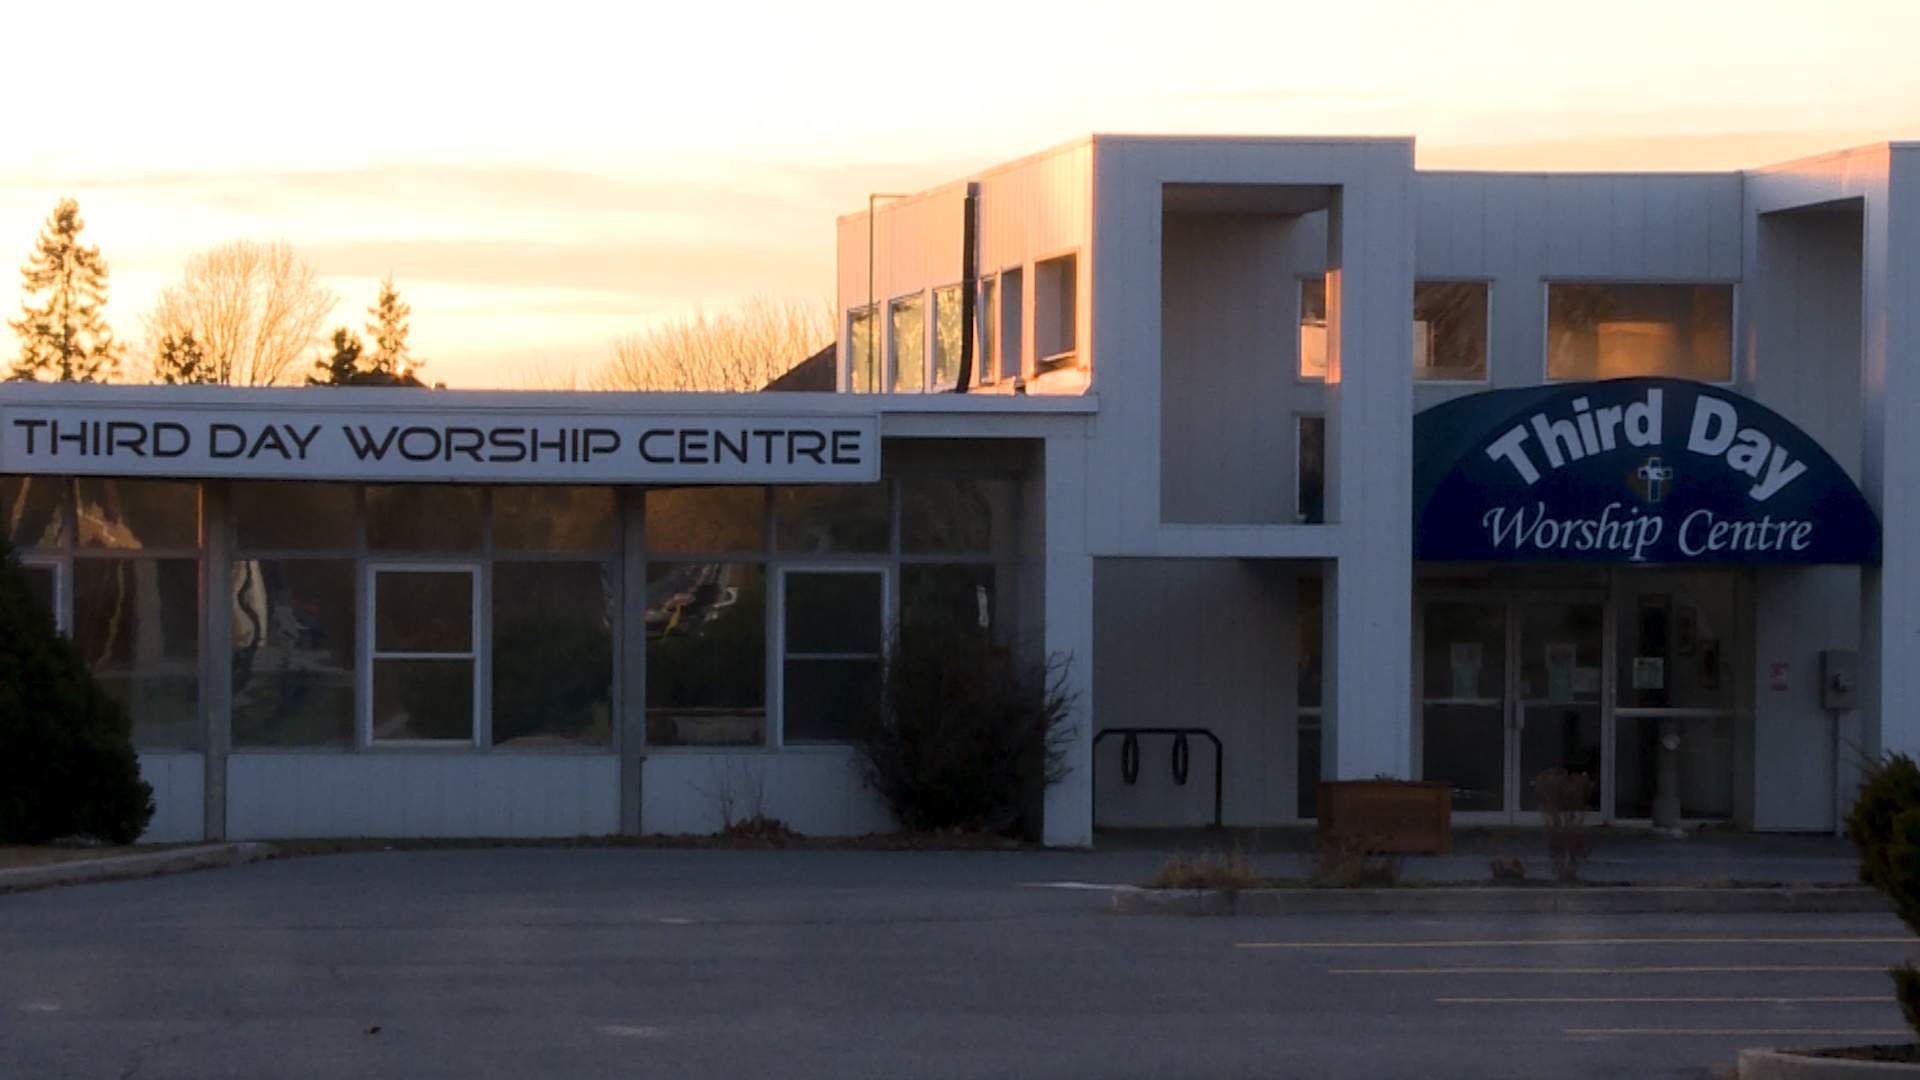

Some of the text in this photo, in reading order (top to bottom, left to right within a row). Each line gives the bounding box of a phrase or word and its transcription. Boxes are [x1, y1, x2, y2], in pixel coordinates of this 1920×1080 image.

[13, 419, 862, 464] THIRD DAY WORSHIP CENTRE
[1485, 388, 1808, 501] Third Day
[1482, 501, 1813, 562] Worship Centre
